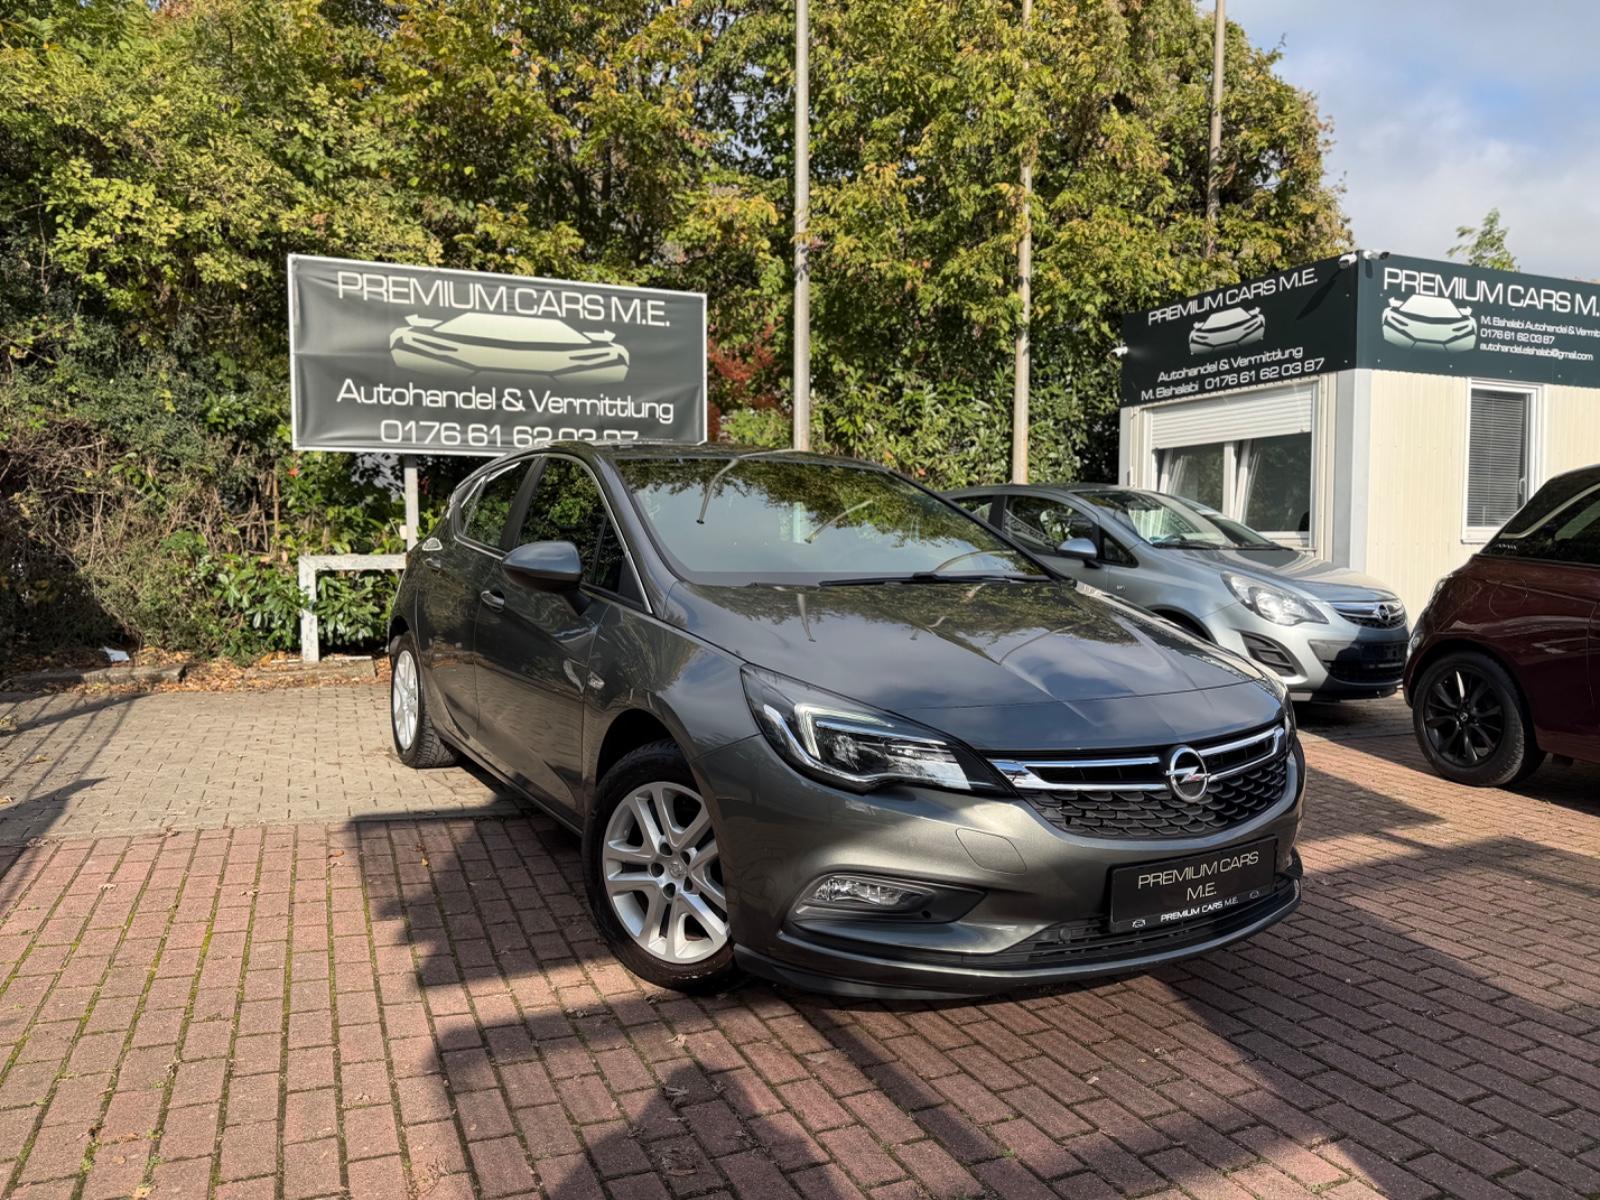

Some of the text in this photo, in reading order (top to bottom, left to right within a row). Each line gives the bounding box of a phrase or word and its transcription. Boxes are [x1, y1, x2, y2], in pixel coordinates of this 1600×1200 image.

[337, 271, 670, 327] PREMIUM CARS M.E.
[1148, 268, 1318, 326] PREMIUM CARS M.E.
[1384, 268, 1503, 305] PREMIUM
[1507, 285, 1571, 313] CARS
[1480, 328, 1555, 345] 0176 61 62 03 87
[1525, 321, 1567, 334] Autohandel
[1568, 325, 1575, 335] &
[1157, 346, 1304, 382] Autohandel & Vermittlung
[1205, 374, 1237, 390] 0176
[1240, 370, 1256, 384] 61
[1260, 366, 1279, 380] 62
[1282, 362, 1302, 376] 03
[1304, 358, 1325, 372] 87
[337, 379, 674, 423] Autohandel & Vermittlung
[380, 420, 461, 446] 0176
[467, 424, 502, 447] 61
[1138, 851, 1258, 890] PREMIUM CARS
[1186, 882, 1217, 902] M.E.
[1161, 906, 1200, 922] PREMIUM
[1202, 901, 1224, 913] CARS
